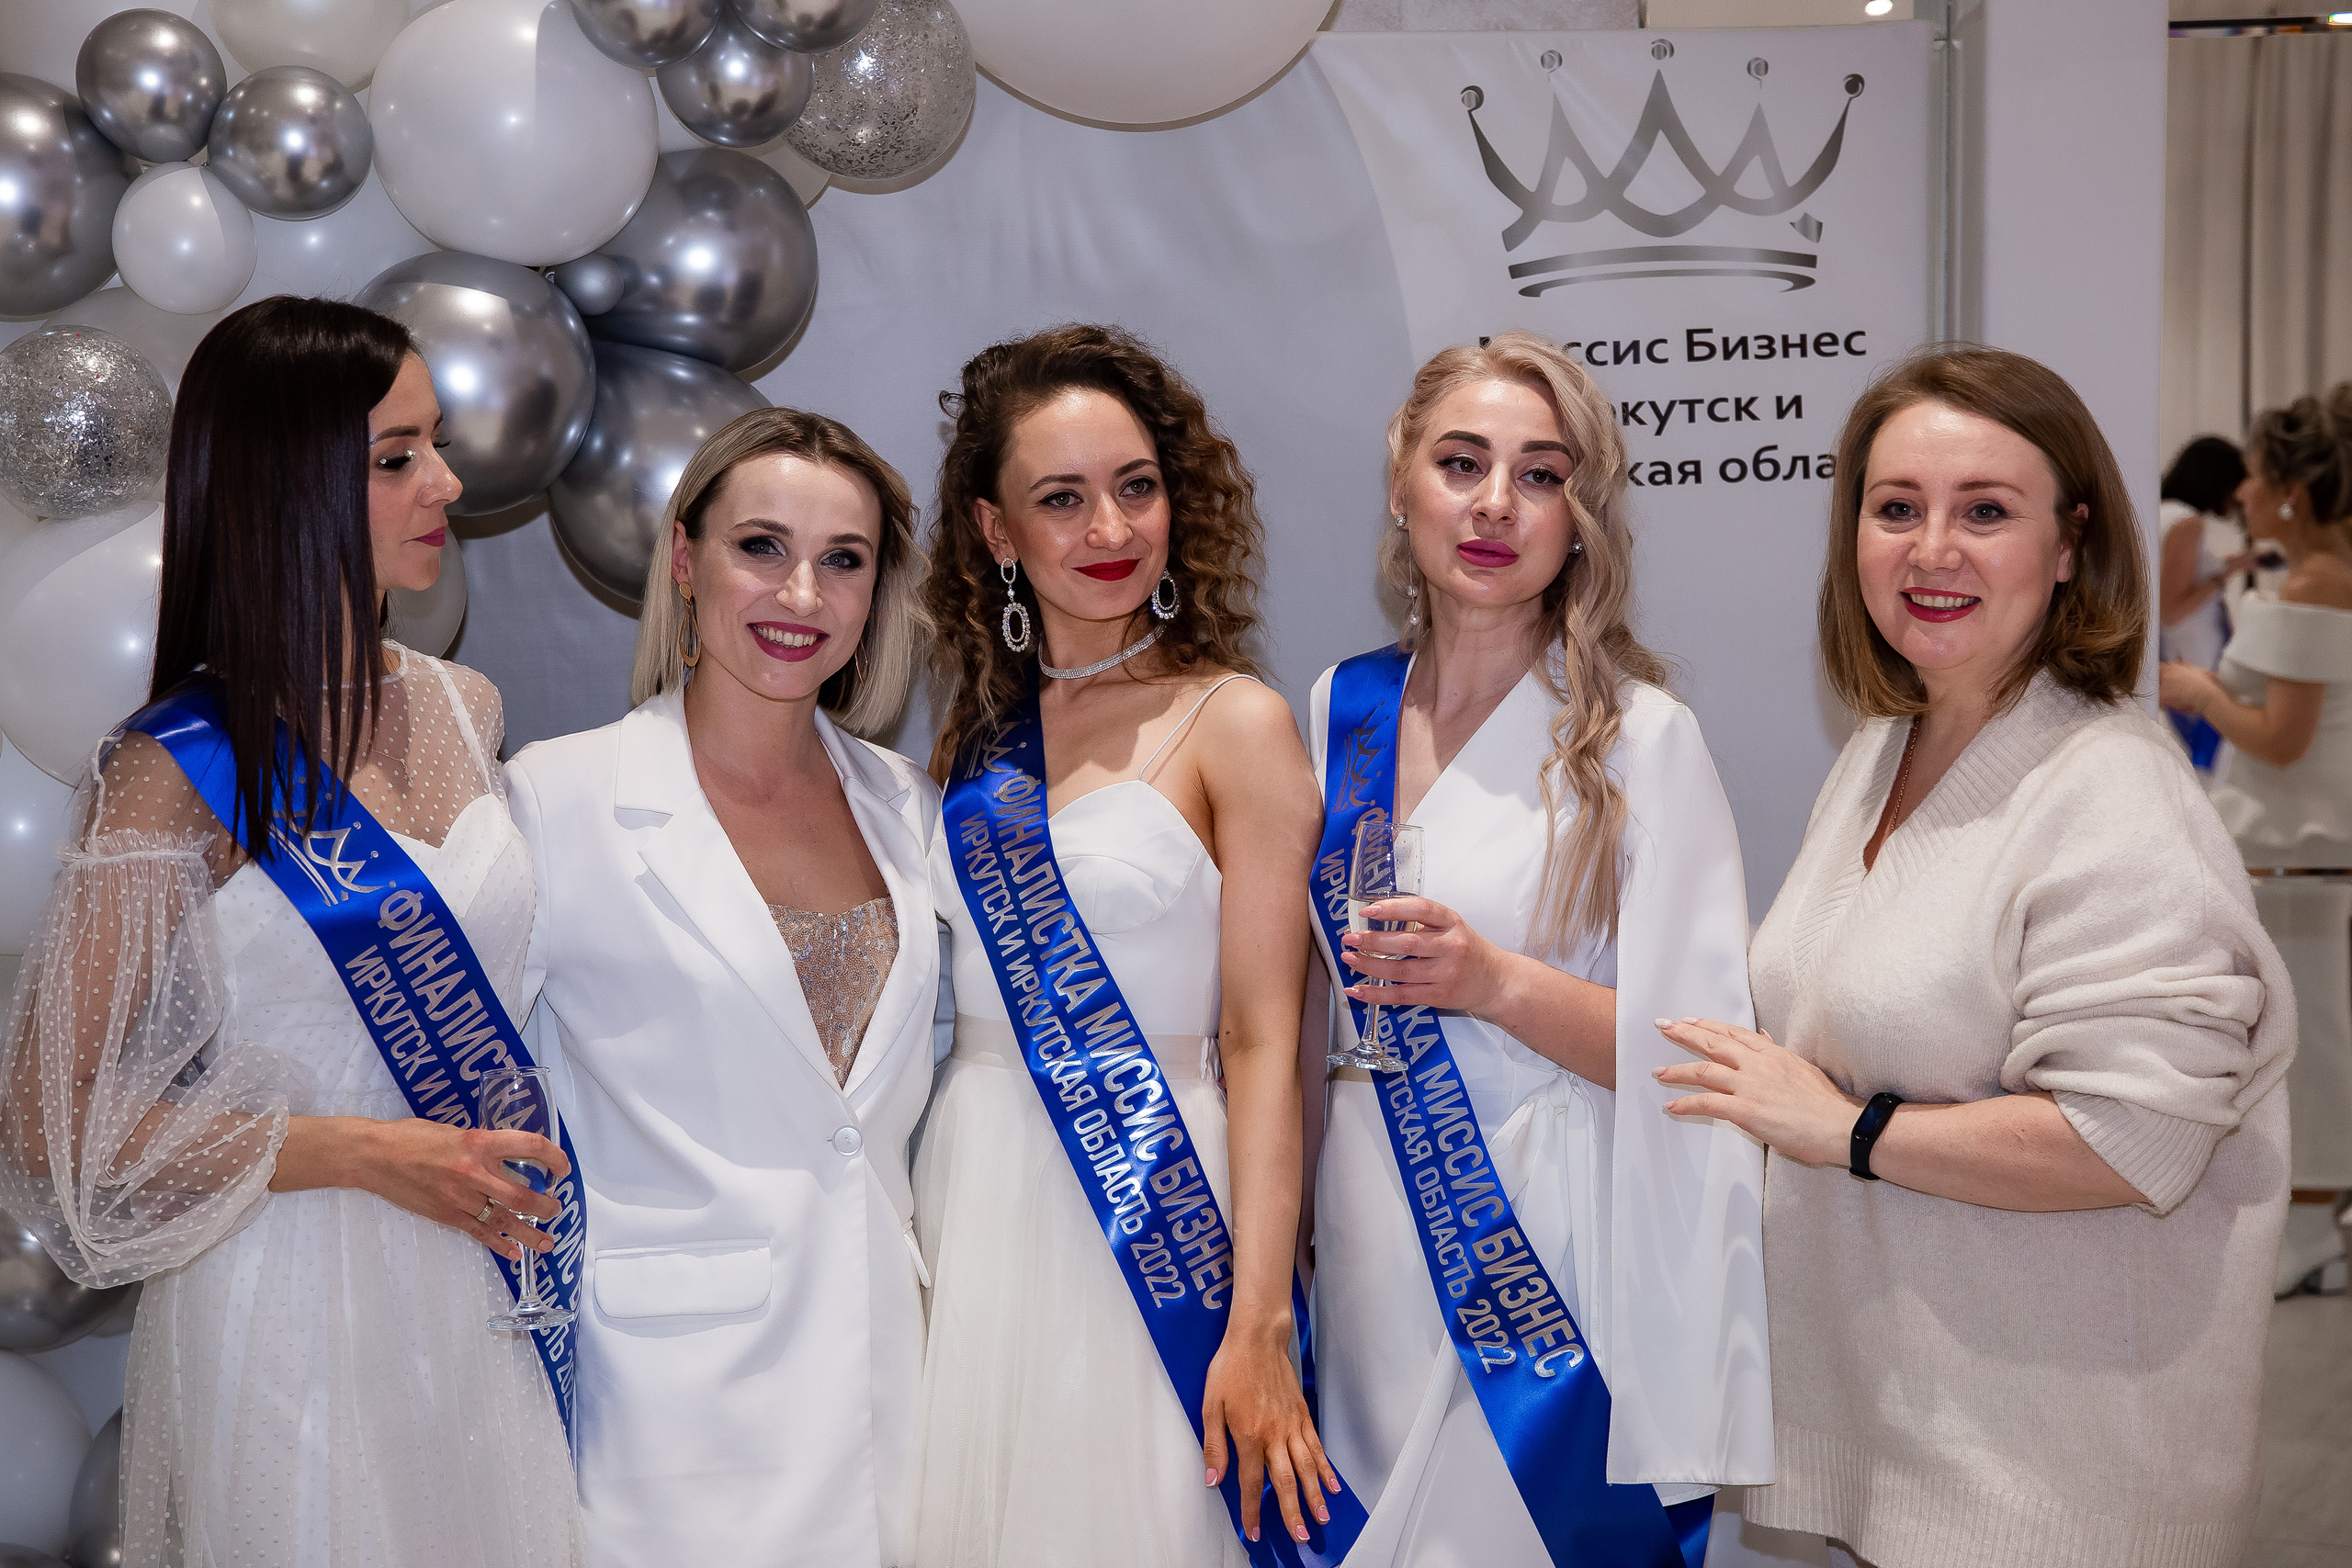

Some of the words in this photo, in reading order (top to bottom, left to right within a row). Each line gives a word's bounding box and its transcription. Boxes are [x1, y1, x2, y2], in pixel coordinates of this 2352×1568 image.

[1685, 327, 1868, 364] Бизнес
[1606, 394, 1761, 436] кутск
[1775, 393, 1804, 421] и
[1718, 444, 1838, 485] обла
[959, 809, 1019, 935] ИРКУТСК
[997, 927, 1027, 958] И
[345, 943, 436, 1081] ИРКУТСК
[412, 1067, 452, 1104] И
[992, 774, 1108, 1014] ФИНАЛИСТКА
[1074, 1001, 1184, 1162] МИССИС
[1148, 1156, 1234, 1311] БИЗНЕС
[1005, 952, 1099, 1112] ИРКУТСКАЯ
[1072, 1108, 1152, 1235] ОБЛАСТЬ
[1414, 1061, 1505, 1229] МИССИС
[1472, 1224, 1586, 1379] БИЗНЕС
[1130, 1231, 1187, 1309] 2022
[1414, 1166, 1476, 1300] ОБЛАСТЬ
[1456, 1297, 1518, 1375] 2022
